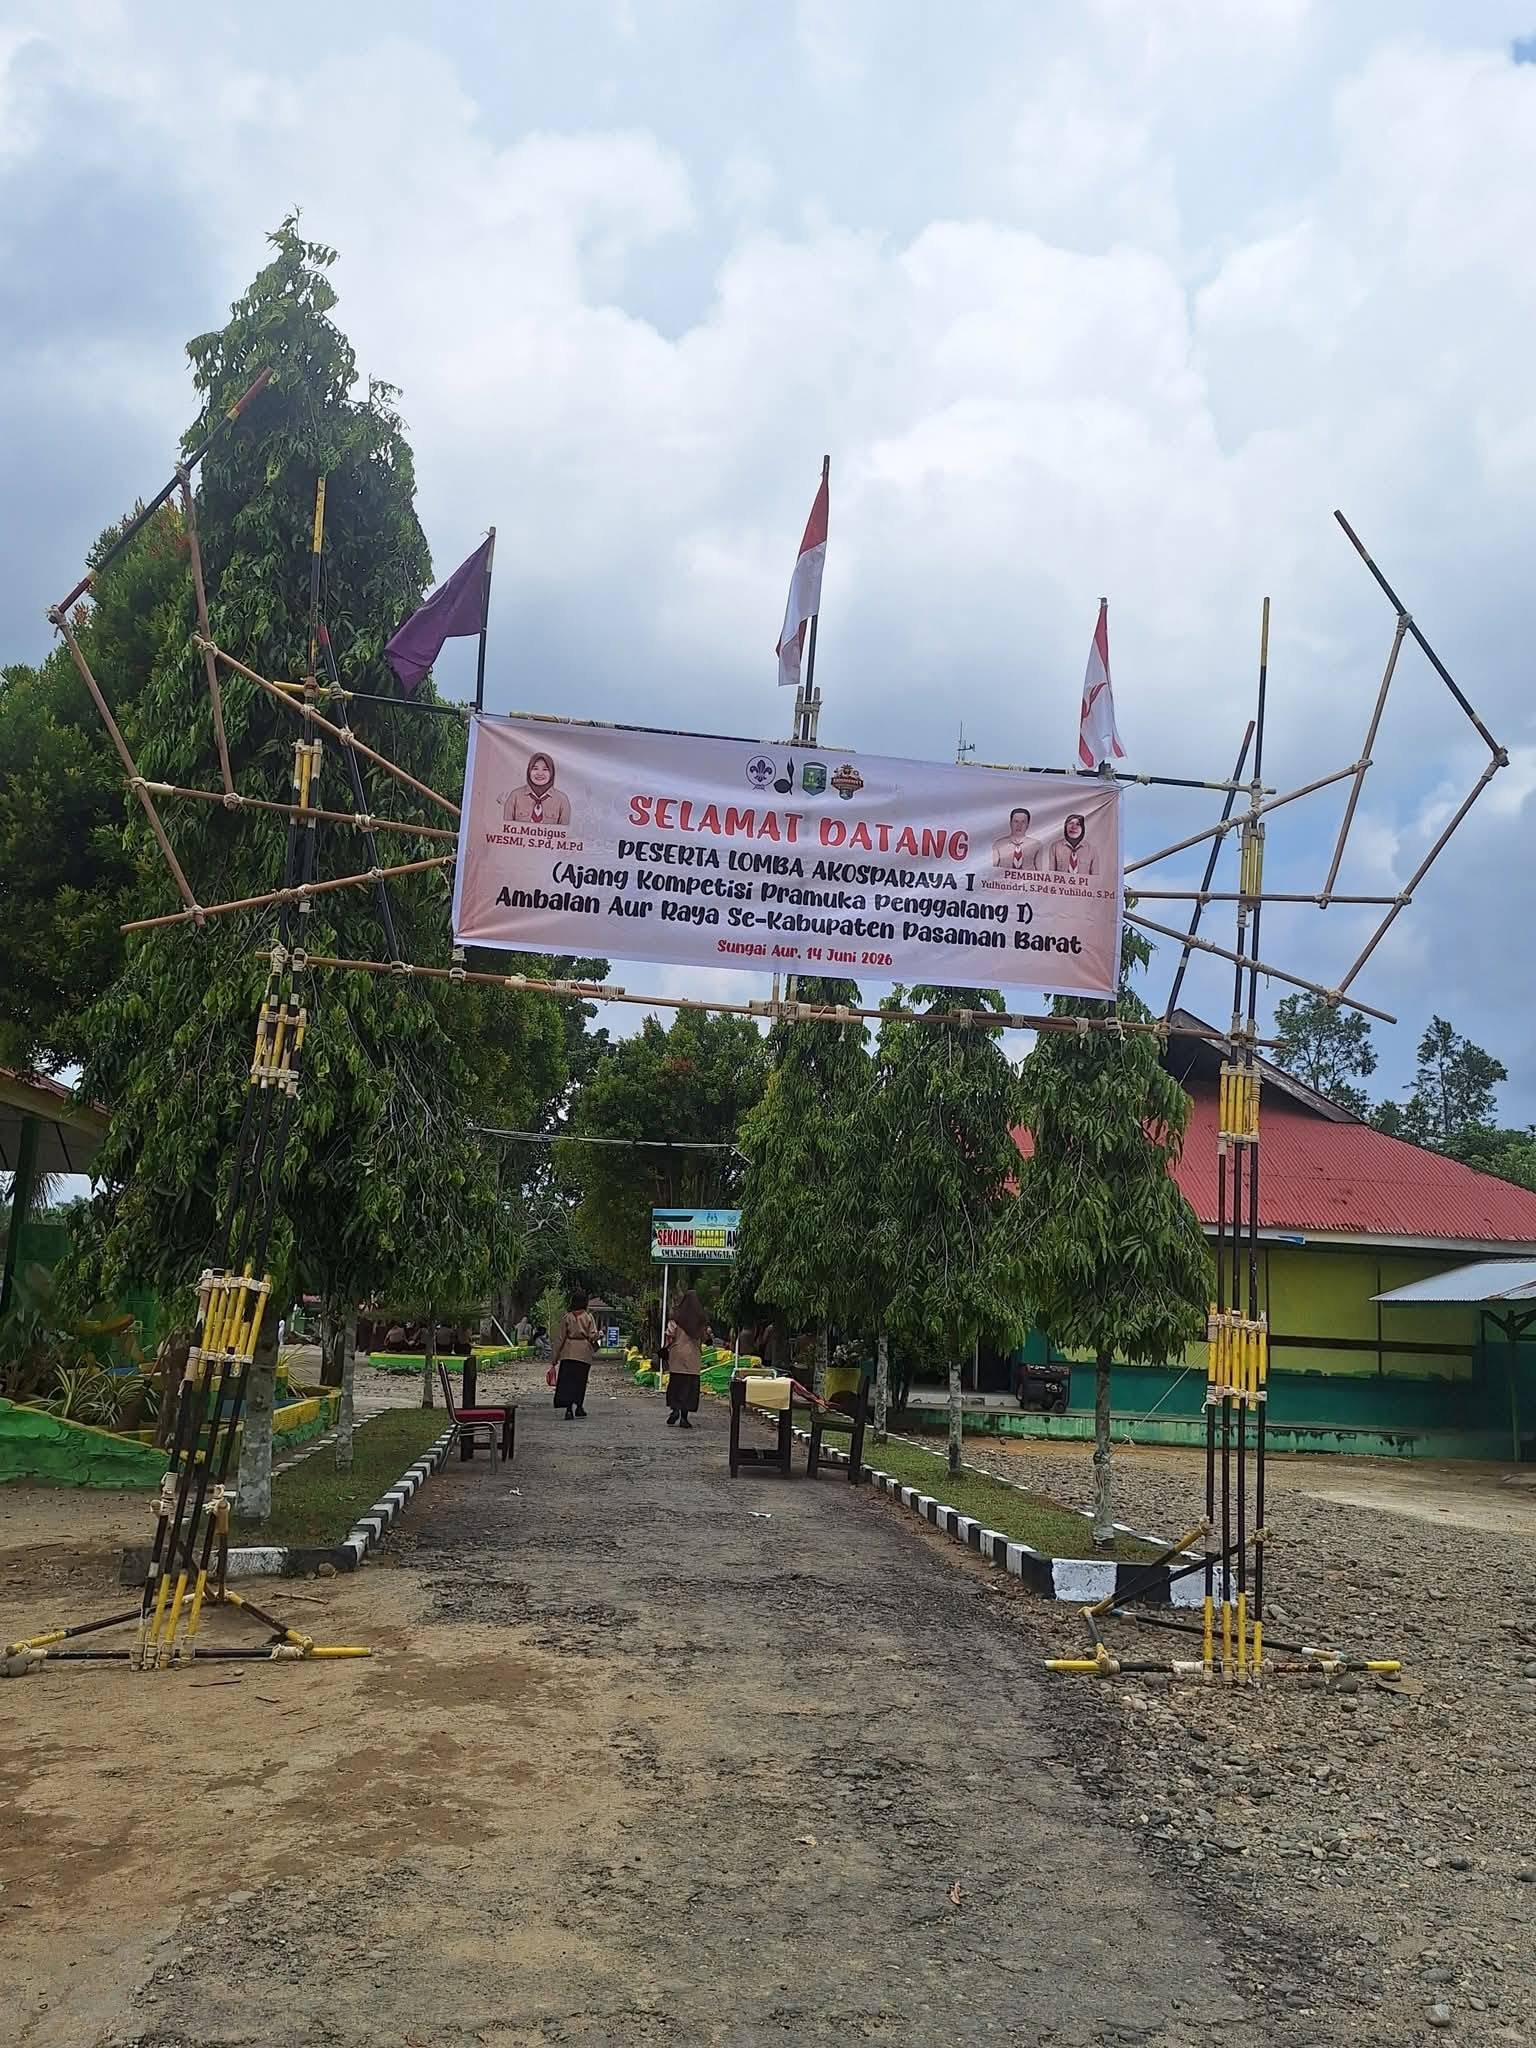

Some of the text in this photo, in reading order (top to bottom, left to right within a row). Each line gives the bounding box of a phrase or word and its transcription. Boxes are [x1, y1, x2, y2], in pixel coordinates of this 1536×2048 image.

[503, 824, 566, 839] Ka.Mabigus
[629, 795, 969, 861] SELAMAT DATANG
[486, 833, 583, 852] WESMI, S.Pd, M.Pd
[618, 839, 976, 891] PESERTA LOMBA AKOSPARAYA I
[1004, 870, 1088, 886] PEMBINA PA & PI
[552, 861, 1033, 924] (Ajang Kompetisi Pramuka Penggalang I)
[1029, 884, 1048, 894] S.Pd
[1050, 885, 1057, 894] &
[1097, 890, 1115, 900] S.Pd
[496, 886, 1082, 955] Ambalan Aur Raya Se-Kabupaten Pasaman Barat
[717, 939, 767, 956] Sungai
[806, 947, 822, 961] 14
[827, 948, 856, 963] Juni
[861, 951, 893, 966] 2026
[657, 1229, 694, 1246] SEKOLAH
